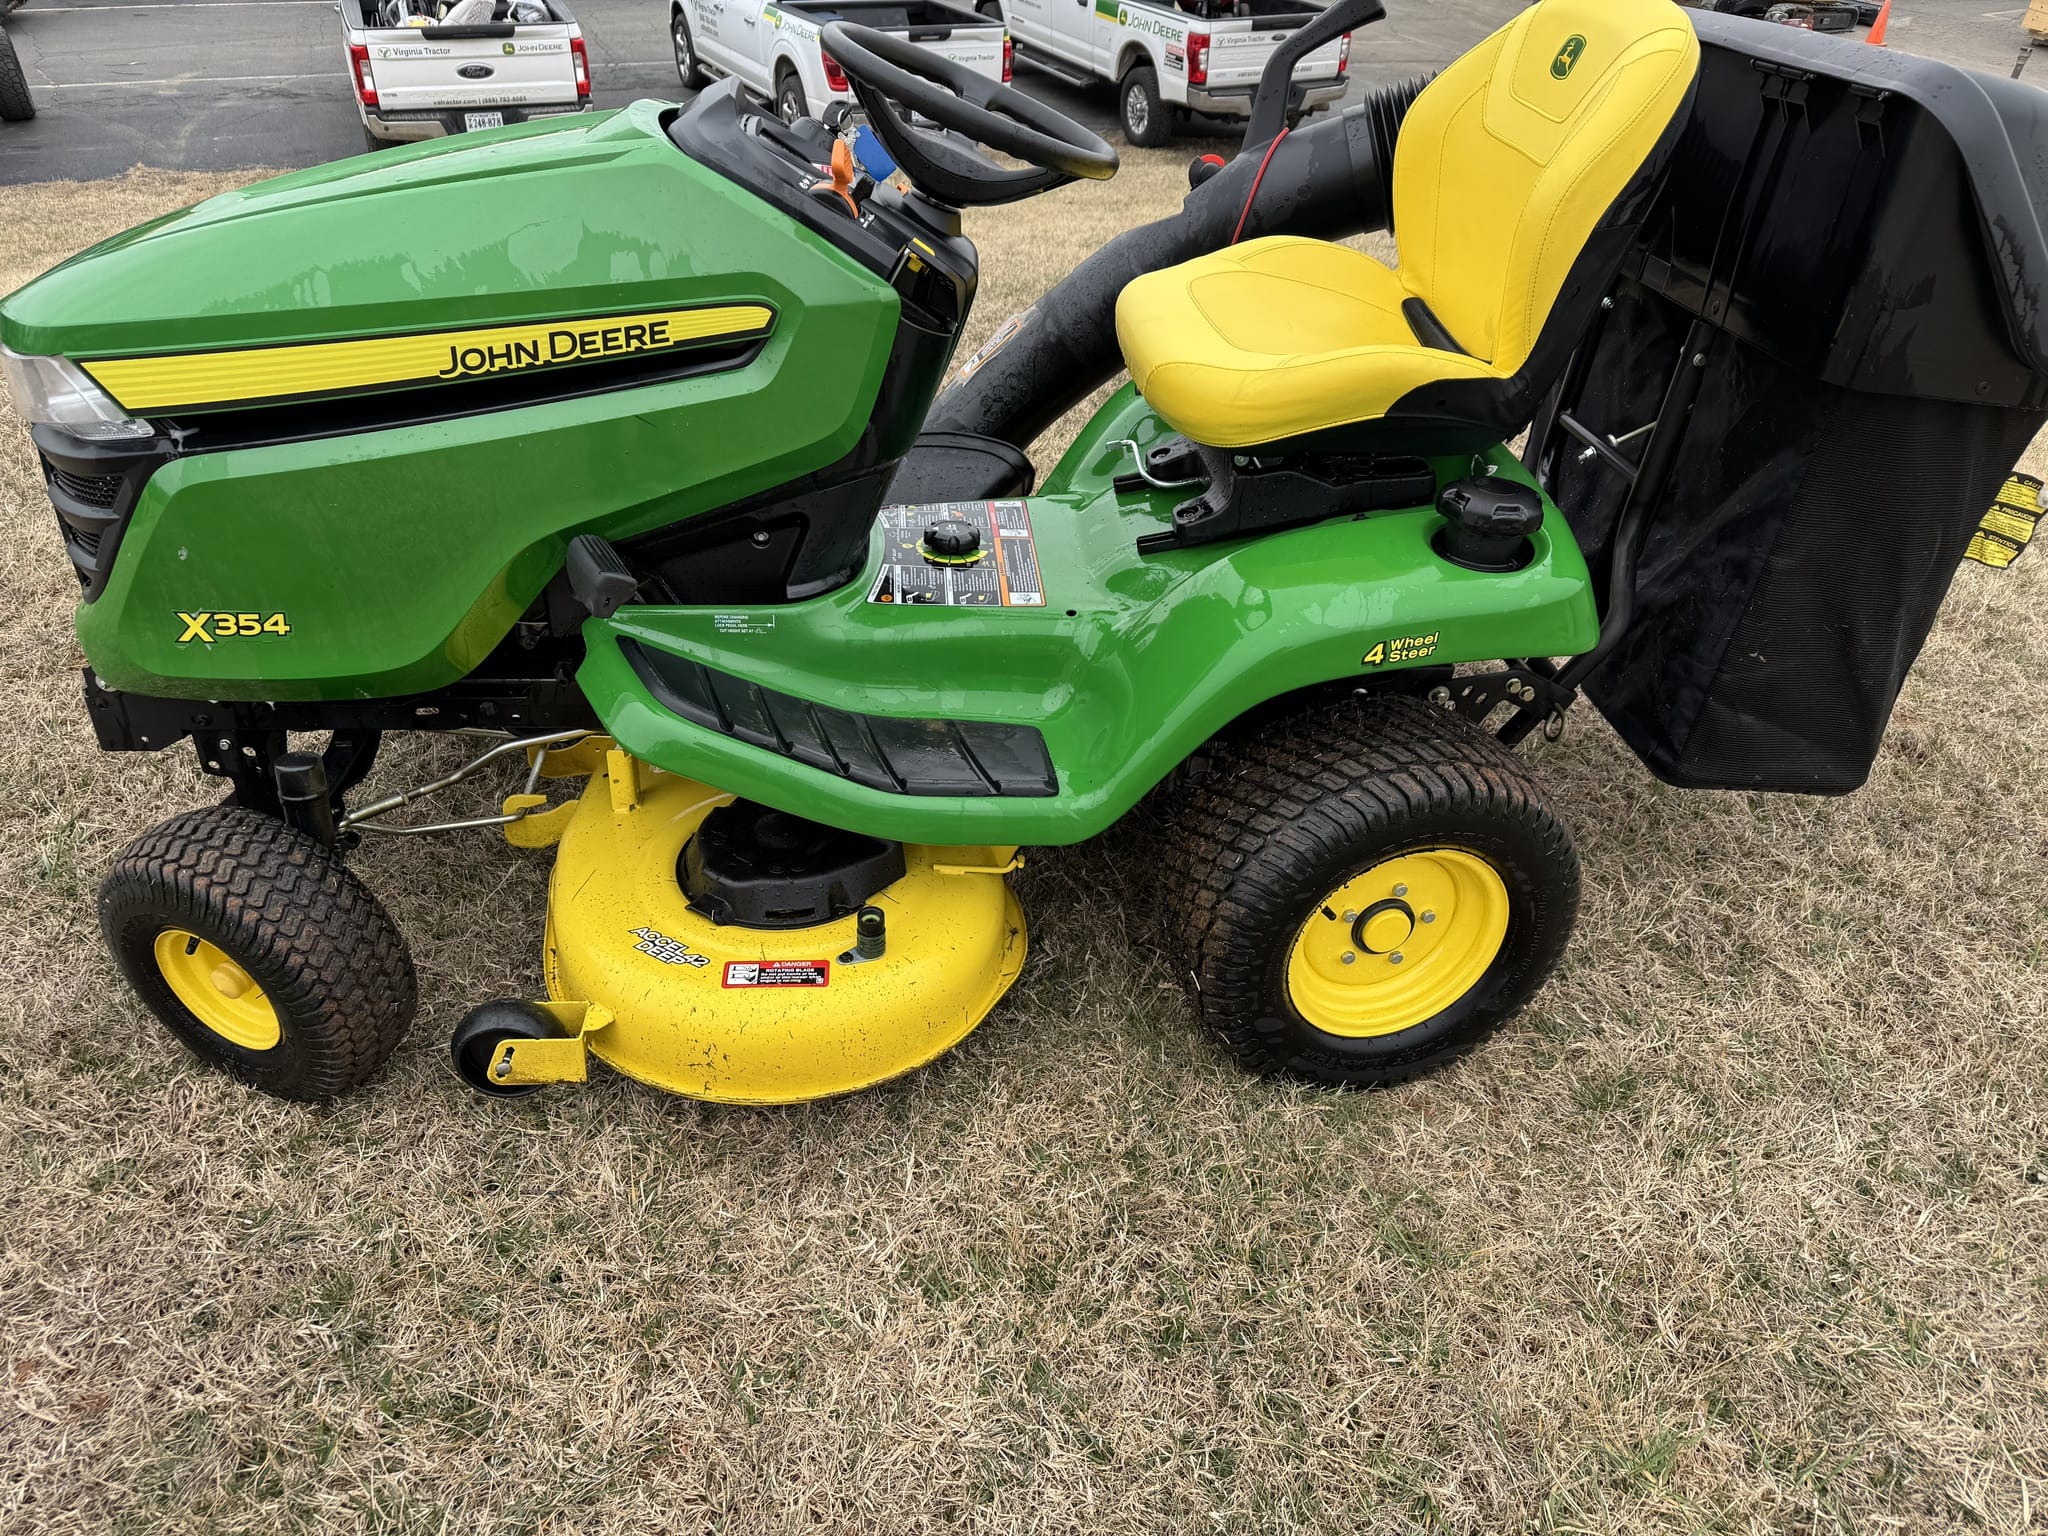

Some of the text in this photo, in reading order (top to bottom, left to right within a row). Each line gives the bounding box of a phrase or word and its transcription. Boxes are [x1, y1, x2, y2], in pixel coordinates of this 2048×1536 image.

[782, 19, 797, 34] JOHN
[1128, 12, 1183, 43] JOHN DEERE
[393, 47, 451, 57] Virginia Tractor
[518, 43, 563, 52] JOHN DEERE
[465, 66, 486, 77] Ford
[438, 320, 673, 378] JOHN DEERE
[175, 612, 292, 643] X354
[1362, 631, 1439, 664] 4 Wheel
[1388, 645, 1436, 662] Steer
[629, 927, 689, 957] ACCEL
[633, 940, 710, 968] DEEP 42
